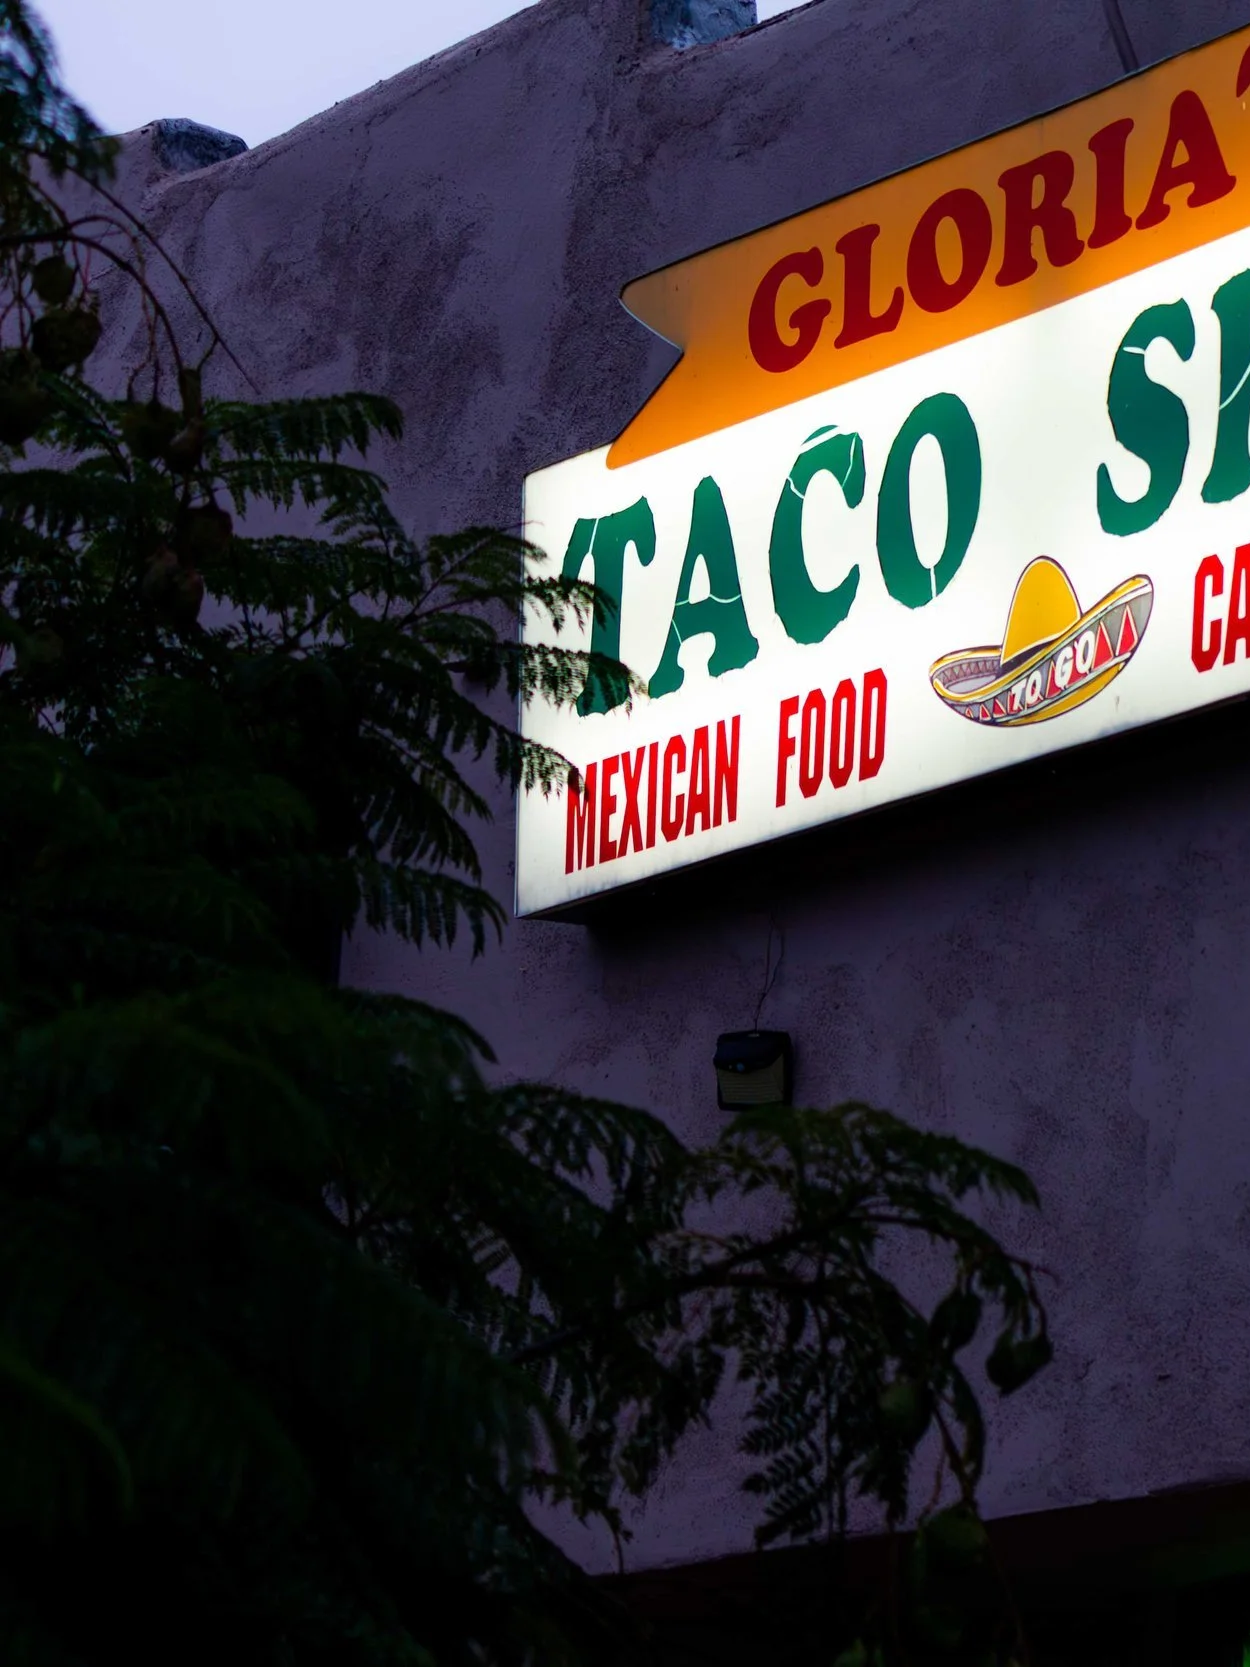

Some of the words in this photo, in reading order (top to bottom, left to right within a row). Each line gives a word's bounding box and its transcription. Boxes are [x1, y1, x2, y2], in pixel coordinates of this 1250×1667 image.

[561, 391, 982, 717] TACO
[565, 714, 741, 875] MEXICAN
[775, 667, 888, 808] FOOD
[1010, 669, 1044, 711] TO
[1053, 630, 1096, 691] GO
